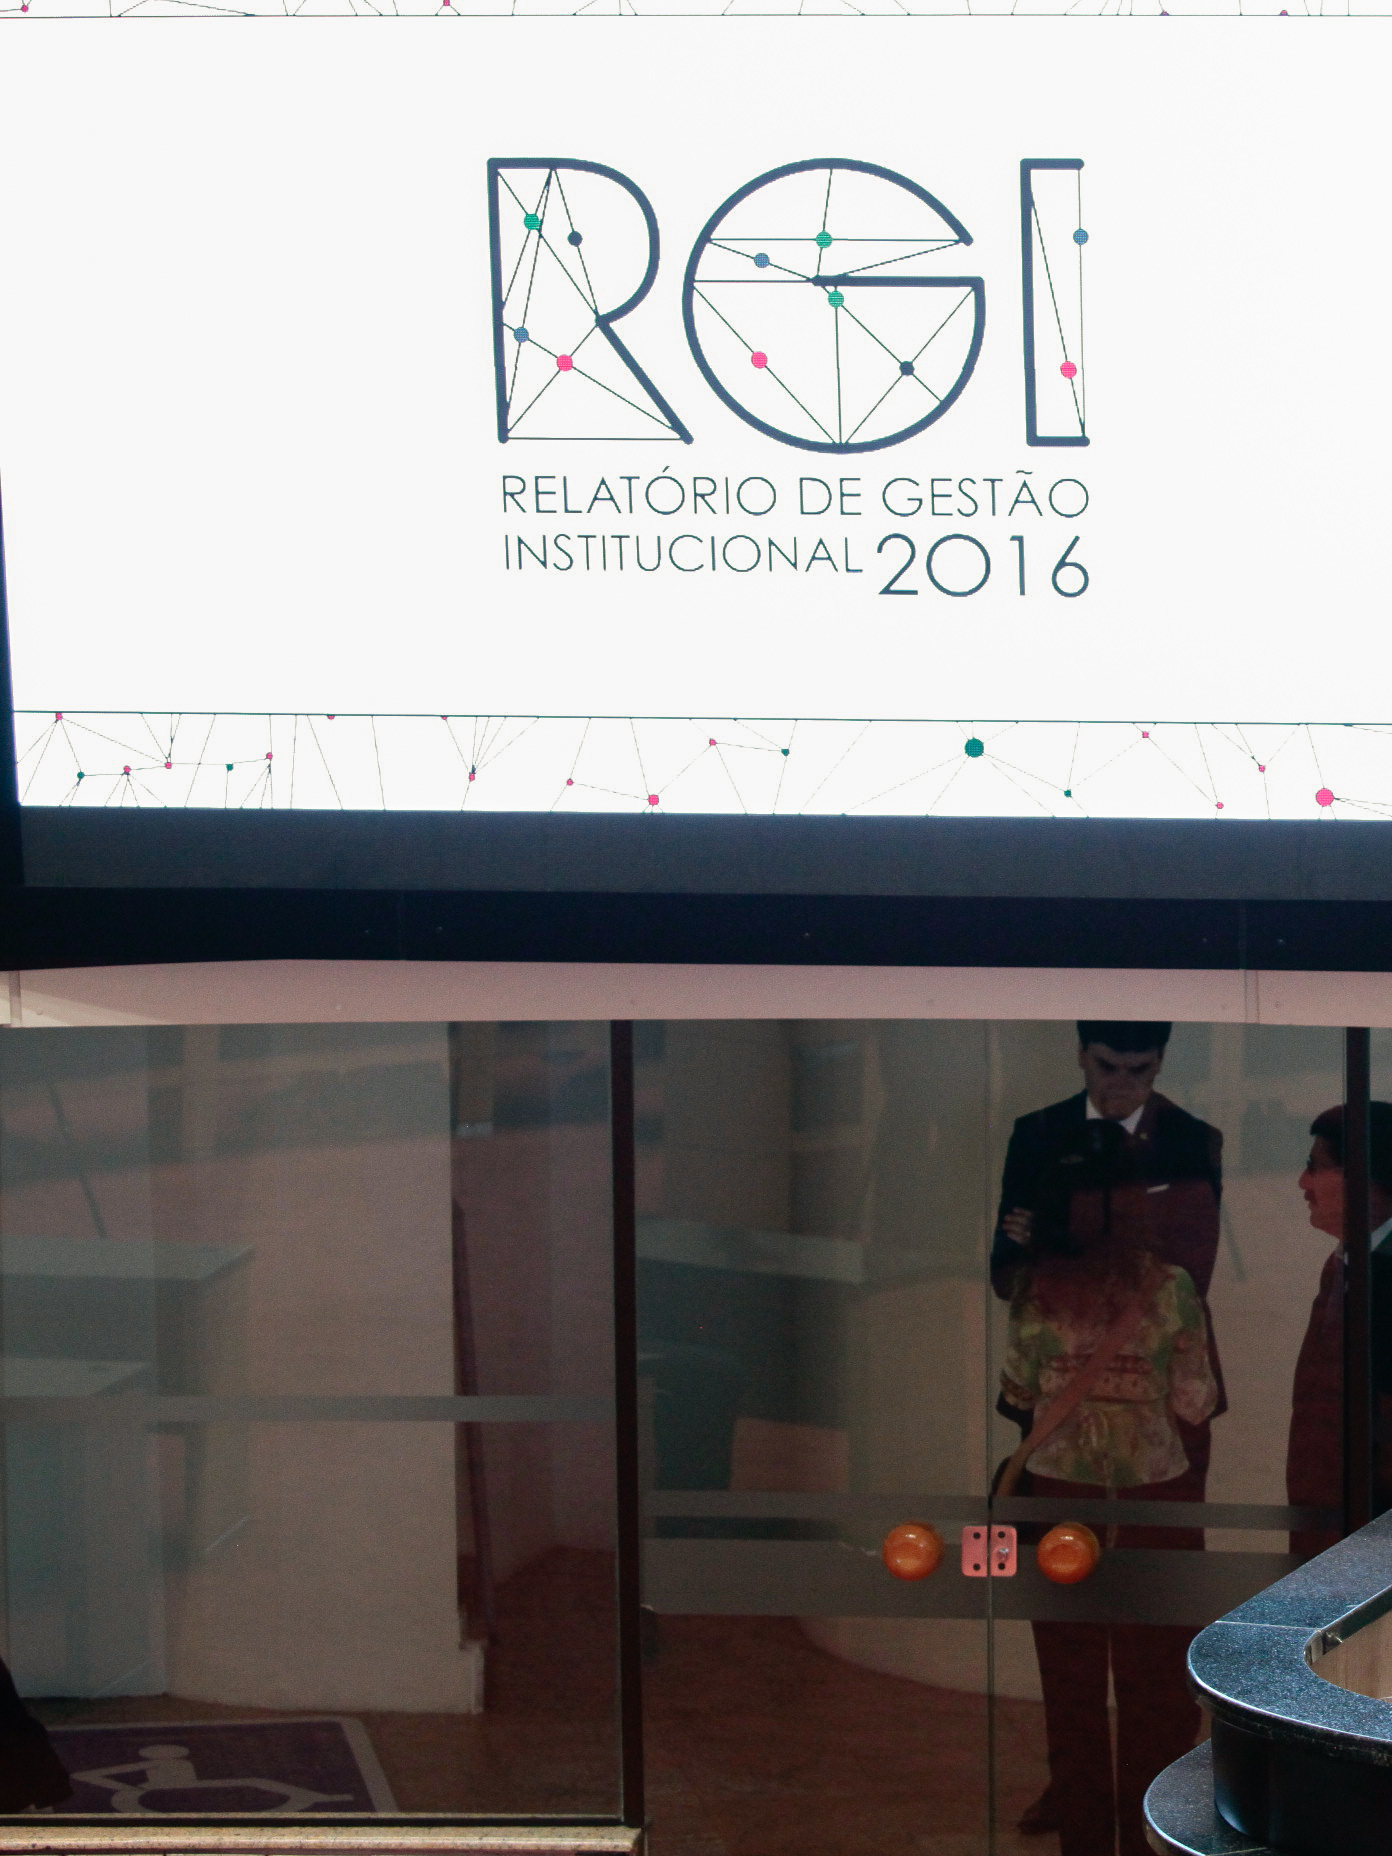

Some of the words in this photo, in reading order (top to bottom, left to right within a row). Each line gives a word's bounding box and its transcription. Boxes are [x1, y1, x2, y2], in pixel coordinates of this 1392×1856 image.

[487, 158, 1090, 454] RGI
[503, 466, 776, 517] RELATÓRIO
[800, 478, 862, 516] DE
[883, 470, 1090, 519] GESTÃO
[505, 534, 864, 573] INSTITUCIONAL
[877, 533, 1090, 598] 2016
